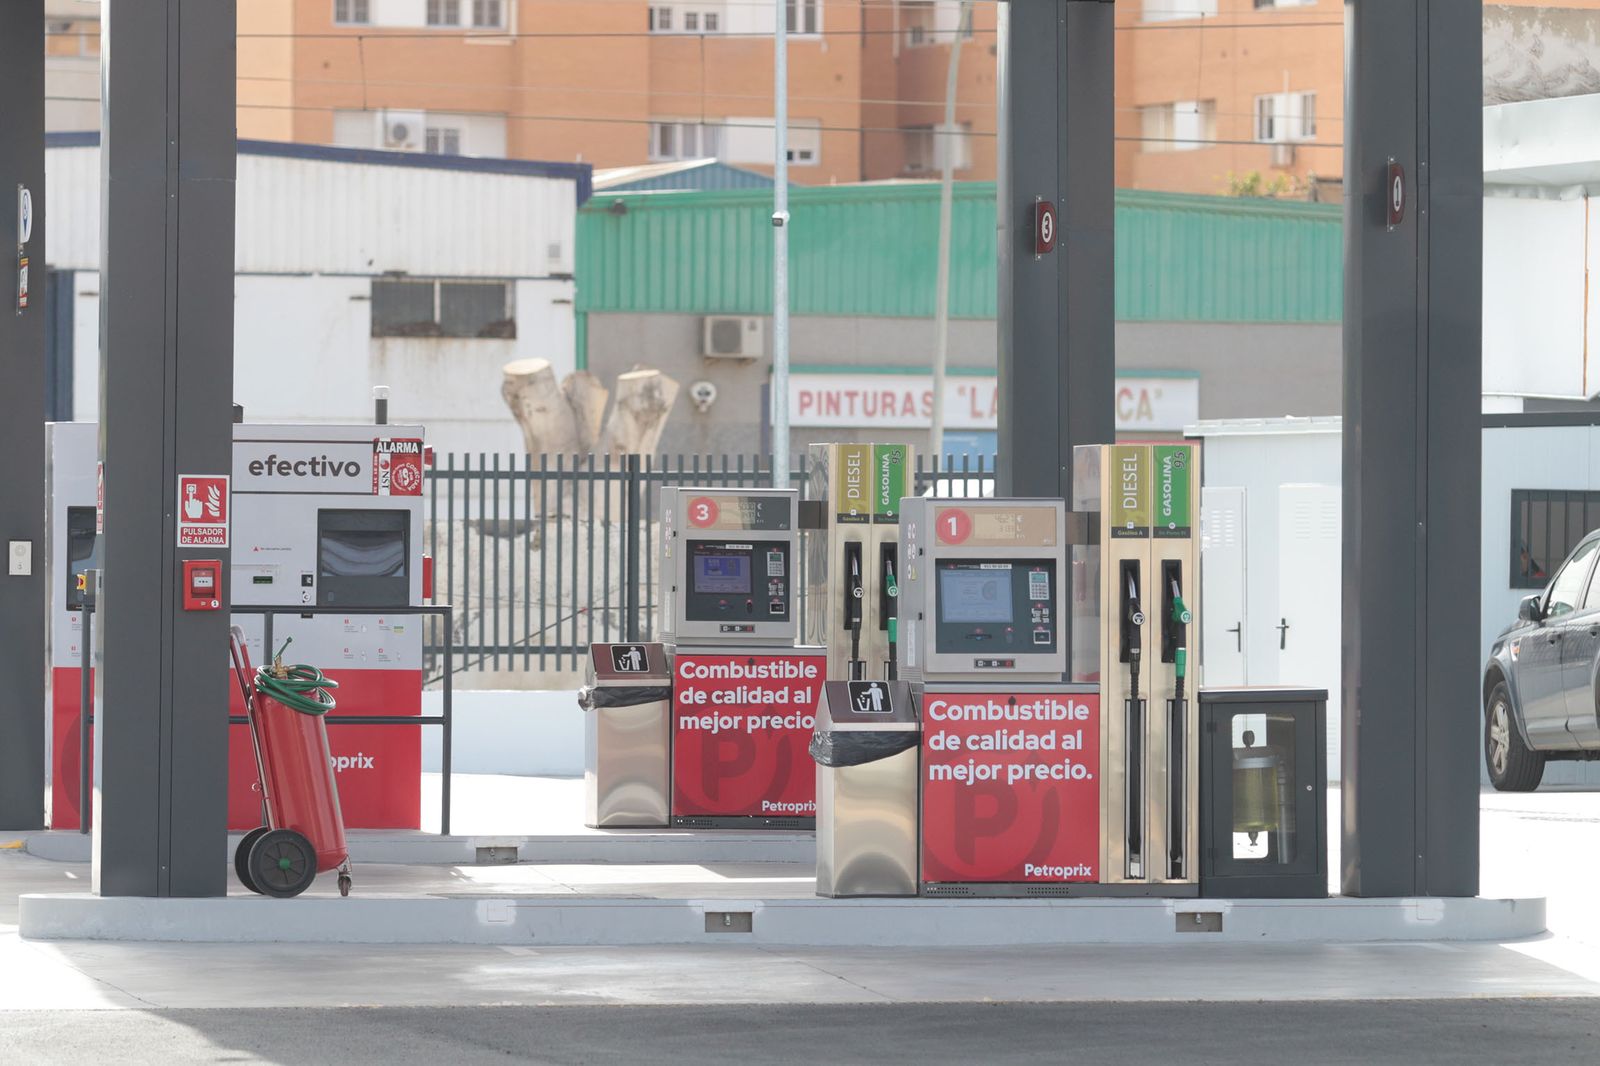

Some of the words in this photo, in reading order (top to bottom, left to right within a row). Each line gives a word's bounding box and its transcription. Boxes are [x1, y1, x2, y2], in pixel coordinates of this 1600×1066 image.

[798, 389, 934, 417] PINTURAS
[376, 442, 419, 453] ALARMA
[248, 454, 361, 477] efectivo
[847, 451, 861, 498] DIESEL
[882, 453, 890, 505] GASOLINA
[892, 449, 901, 464] 95
[1123, 453, 1137, 509] DIESEL
[1163, 455, 1172, 516] GASOLINA
[1173, 451, 1185, 468] 95
[696, 504, 709, 520] 3
[183, 528, 223, 536] PULSADOR
[948, 517, 957, 536] 1
[182, 536, 192, 544] DE
[193, 536, 225, 544] ALARMA
[679, 660, 818, 679] Combustible
[679, 686, 707, 704] de
[711, 685, 789, 704] calidad
[793, 686, 812, 704] al
[929, 699, 1089, 721] Combustible
[679, 711, 743, 734] mejor
[747, 711, 816, 734] precio
[928, 730, 961, 750] de
[966, 729, 1056, 750] calidad
[1061, 729, 1083, 750] al
[929, 758, 1002, 785] mejor
[1008, 758, 1093, 785] precio.
[1024, 863, 1092, 879] Petroprix
